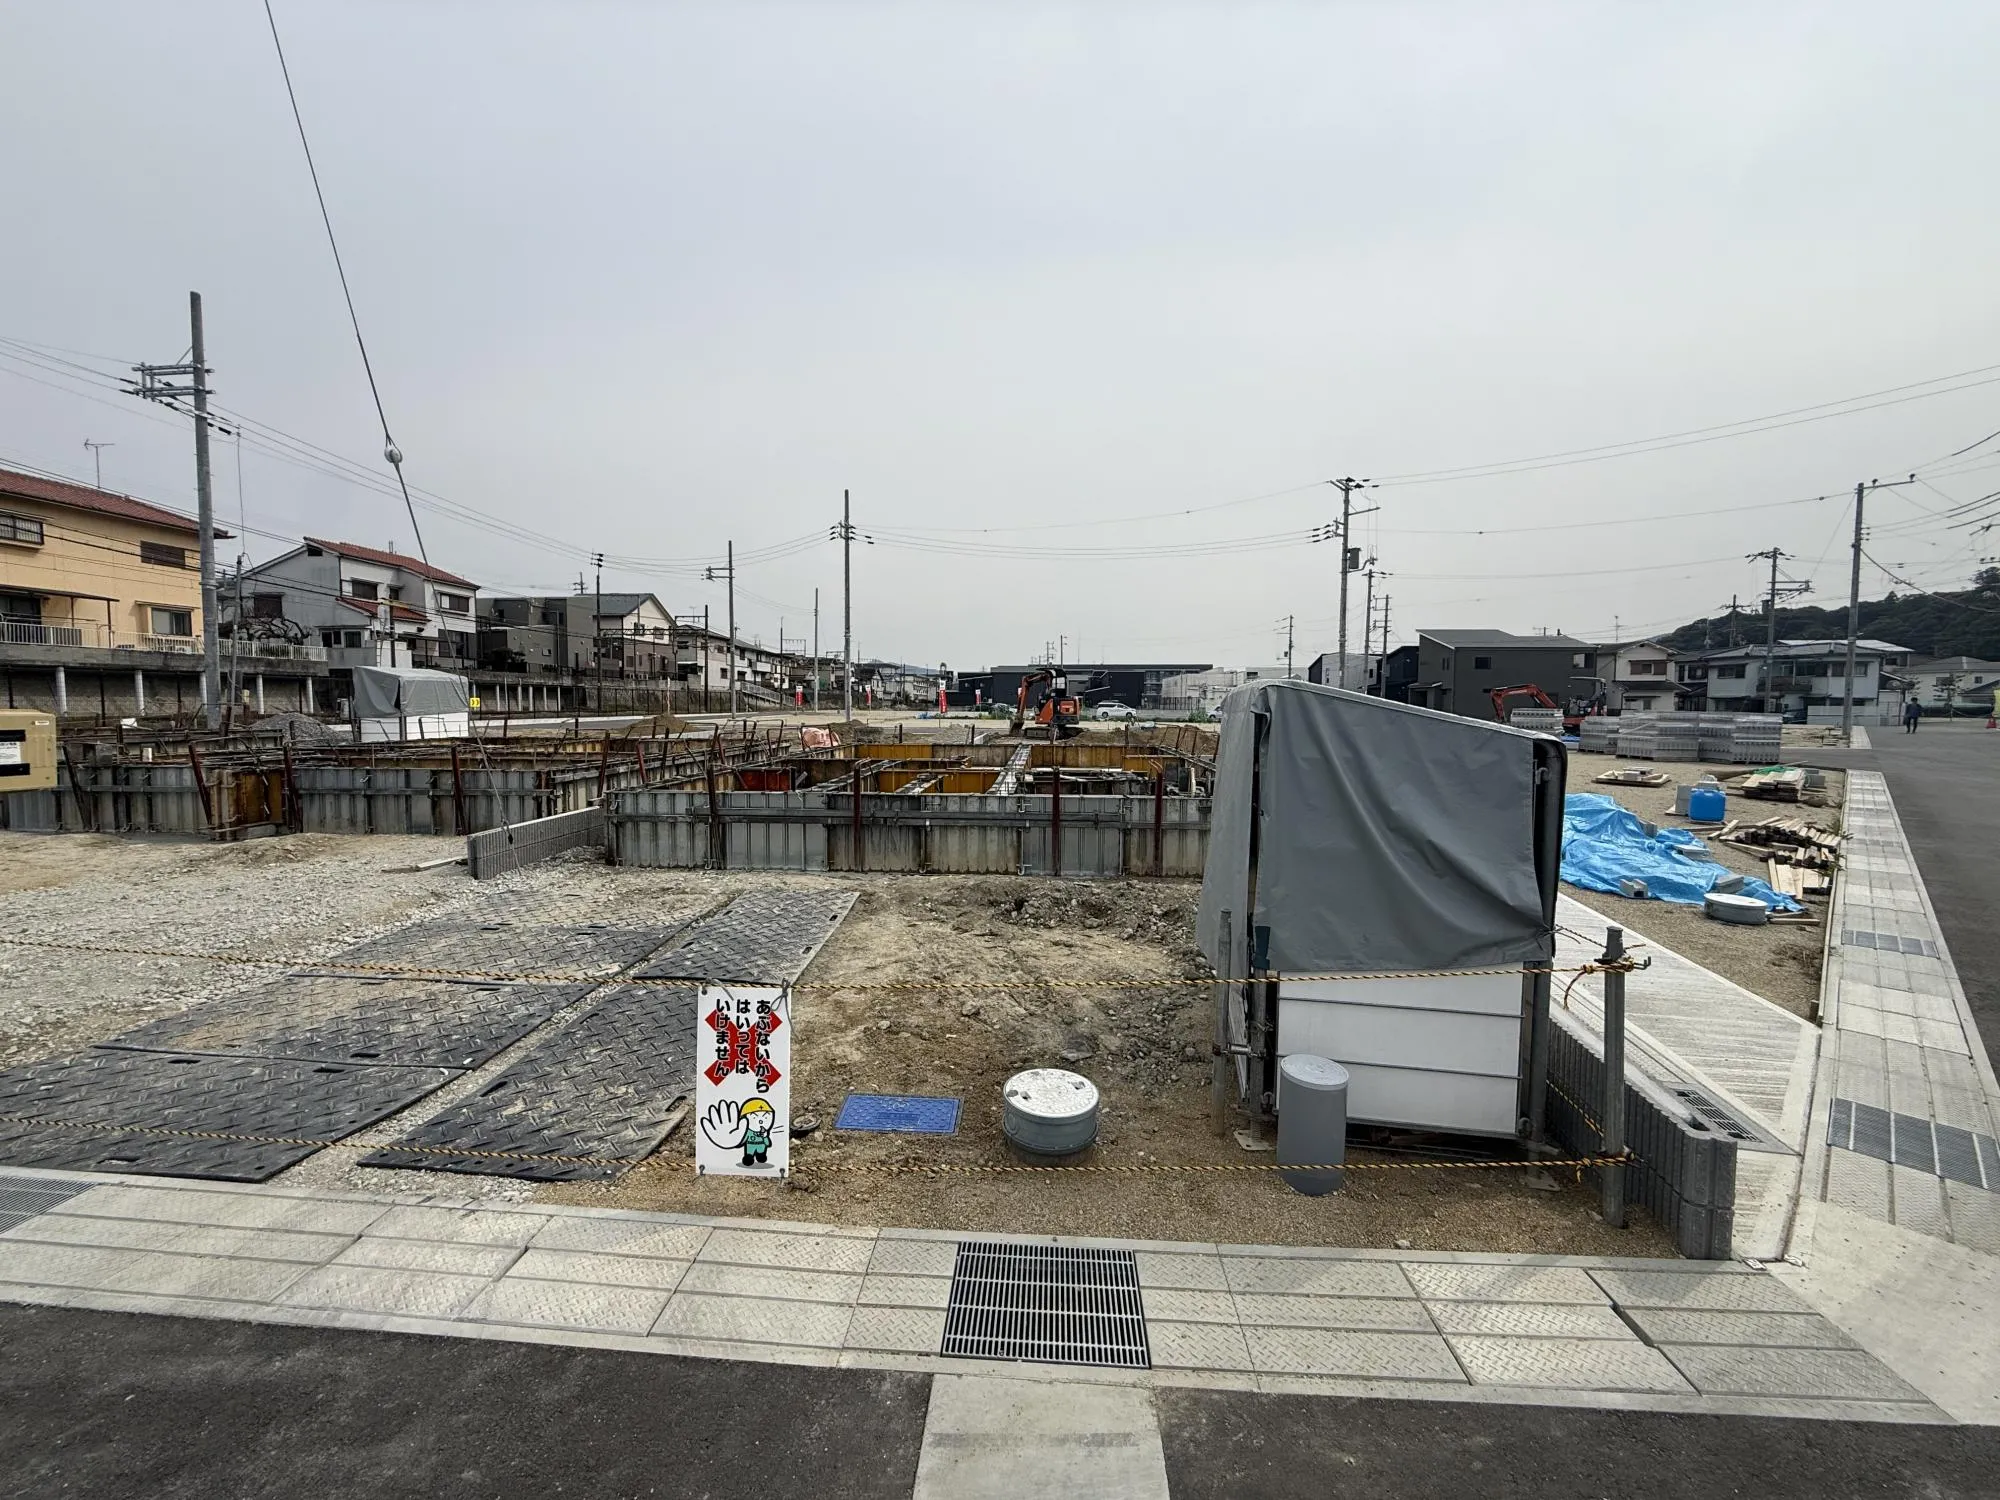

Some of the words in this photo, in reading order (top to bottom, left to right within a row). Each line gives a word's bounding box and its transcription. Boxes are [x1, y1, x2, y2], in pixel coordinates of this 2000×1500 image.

[714, 999, 731, 1077] いけません
[735, 999, 750, 1075] はいっては
[755, 1000, 771, 1094] あぶないから
